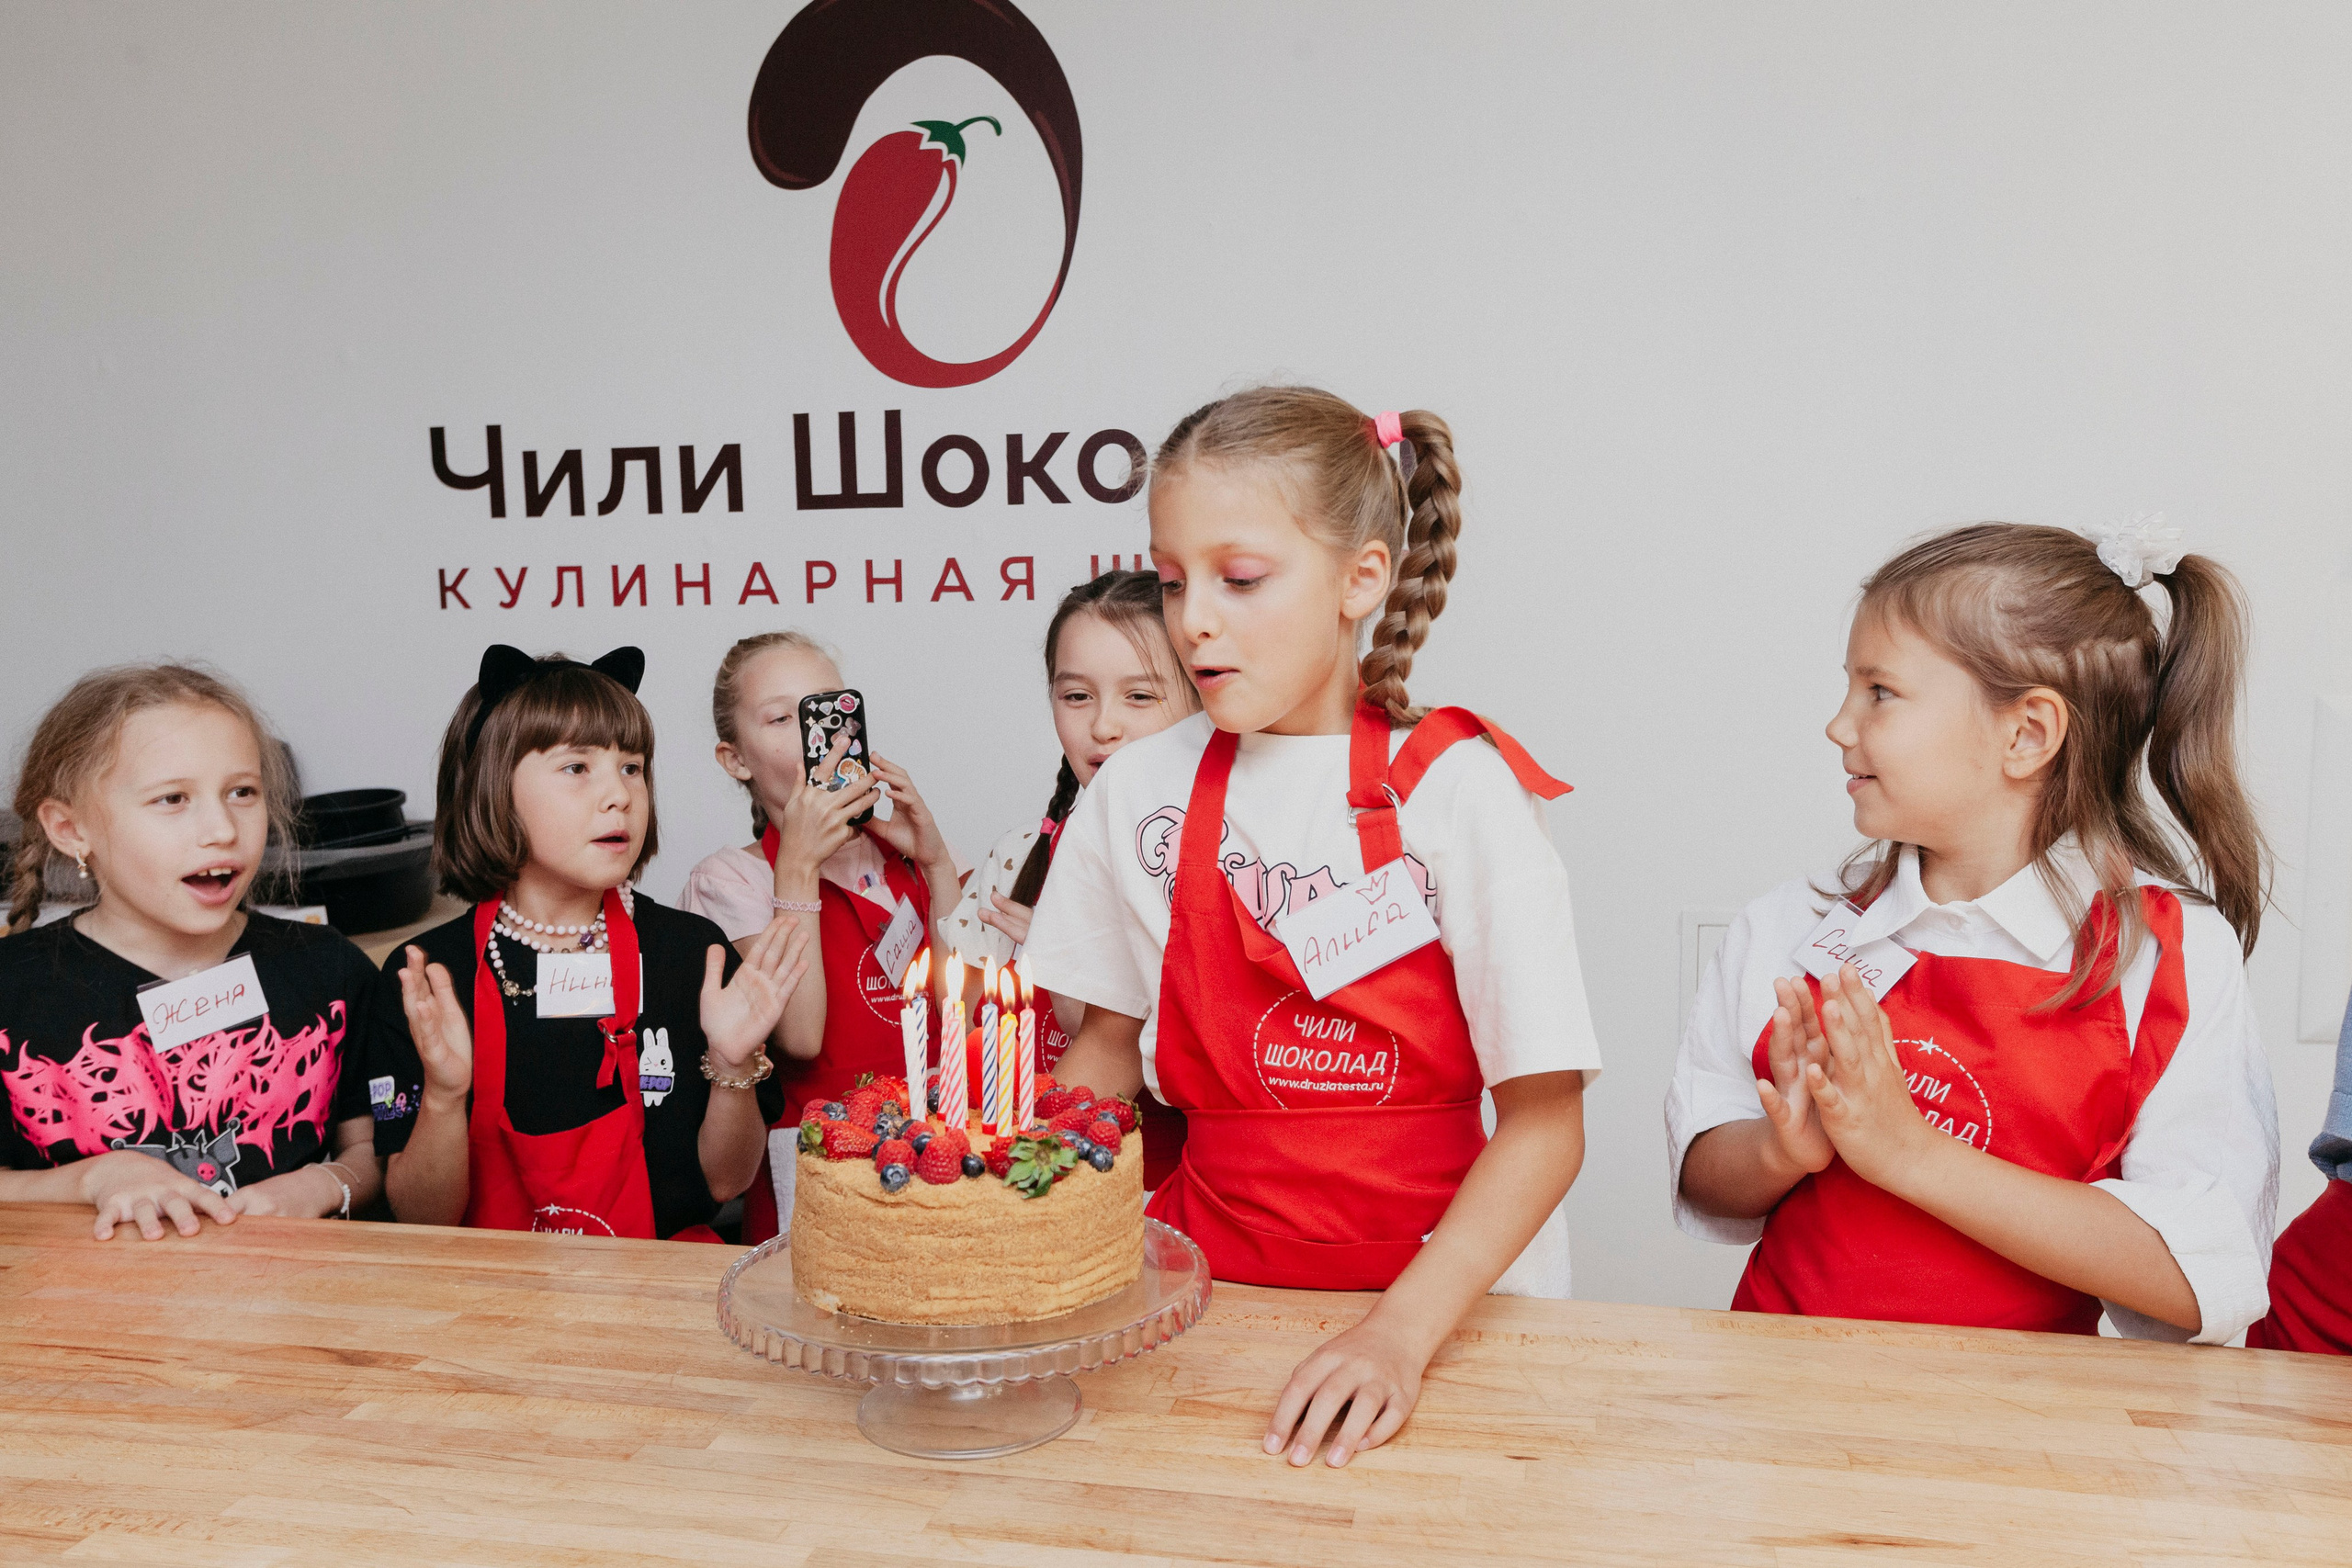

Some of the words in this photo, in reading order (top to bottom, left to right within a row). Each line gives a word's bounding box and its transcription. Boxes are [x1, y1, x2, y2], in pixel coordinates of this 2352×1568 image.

[429, 424, 744, 519] Чили
[793, 409, 1148, 511] Шоко
[438, 556, 1035, 610] КУЛИНАРНАЯ
[549, 967, 613, 995] Нин
[1294, 1013, 1357, 1043] ЧИЛИ
[1264, 1043, 1388, 1077] ШОКОЛАД
[1904, 1069, 1951, 1103] ИЛИ
